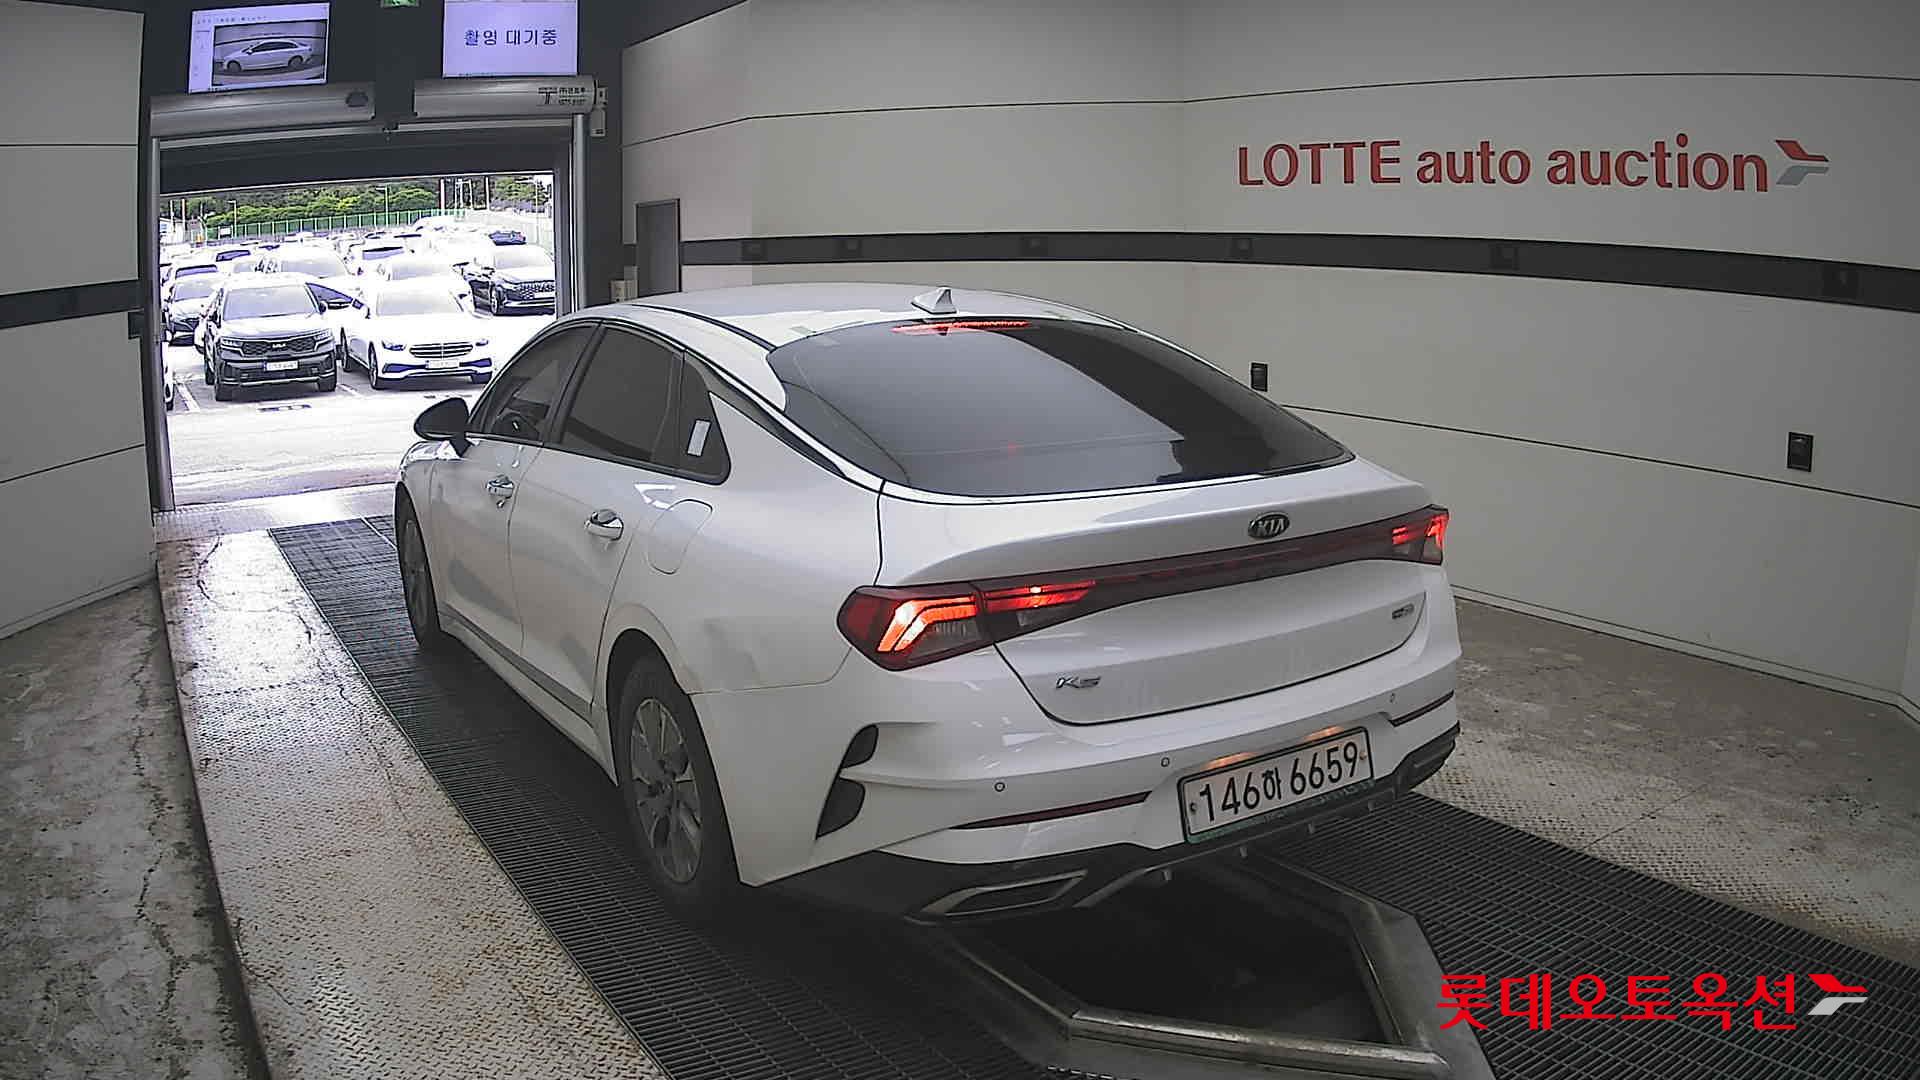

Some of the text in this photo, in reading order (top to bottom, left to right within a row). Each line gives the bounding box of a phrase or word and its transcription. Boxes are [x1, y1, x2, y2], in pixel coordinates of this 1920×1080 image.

[506, 30, 558, 46] 대기중
[1238, 134, 1769, 193] LOTTE auto auction
[1056, 676, 1101, 689] K5
